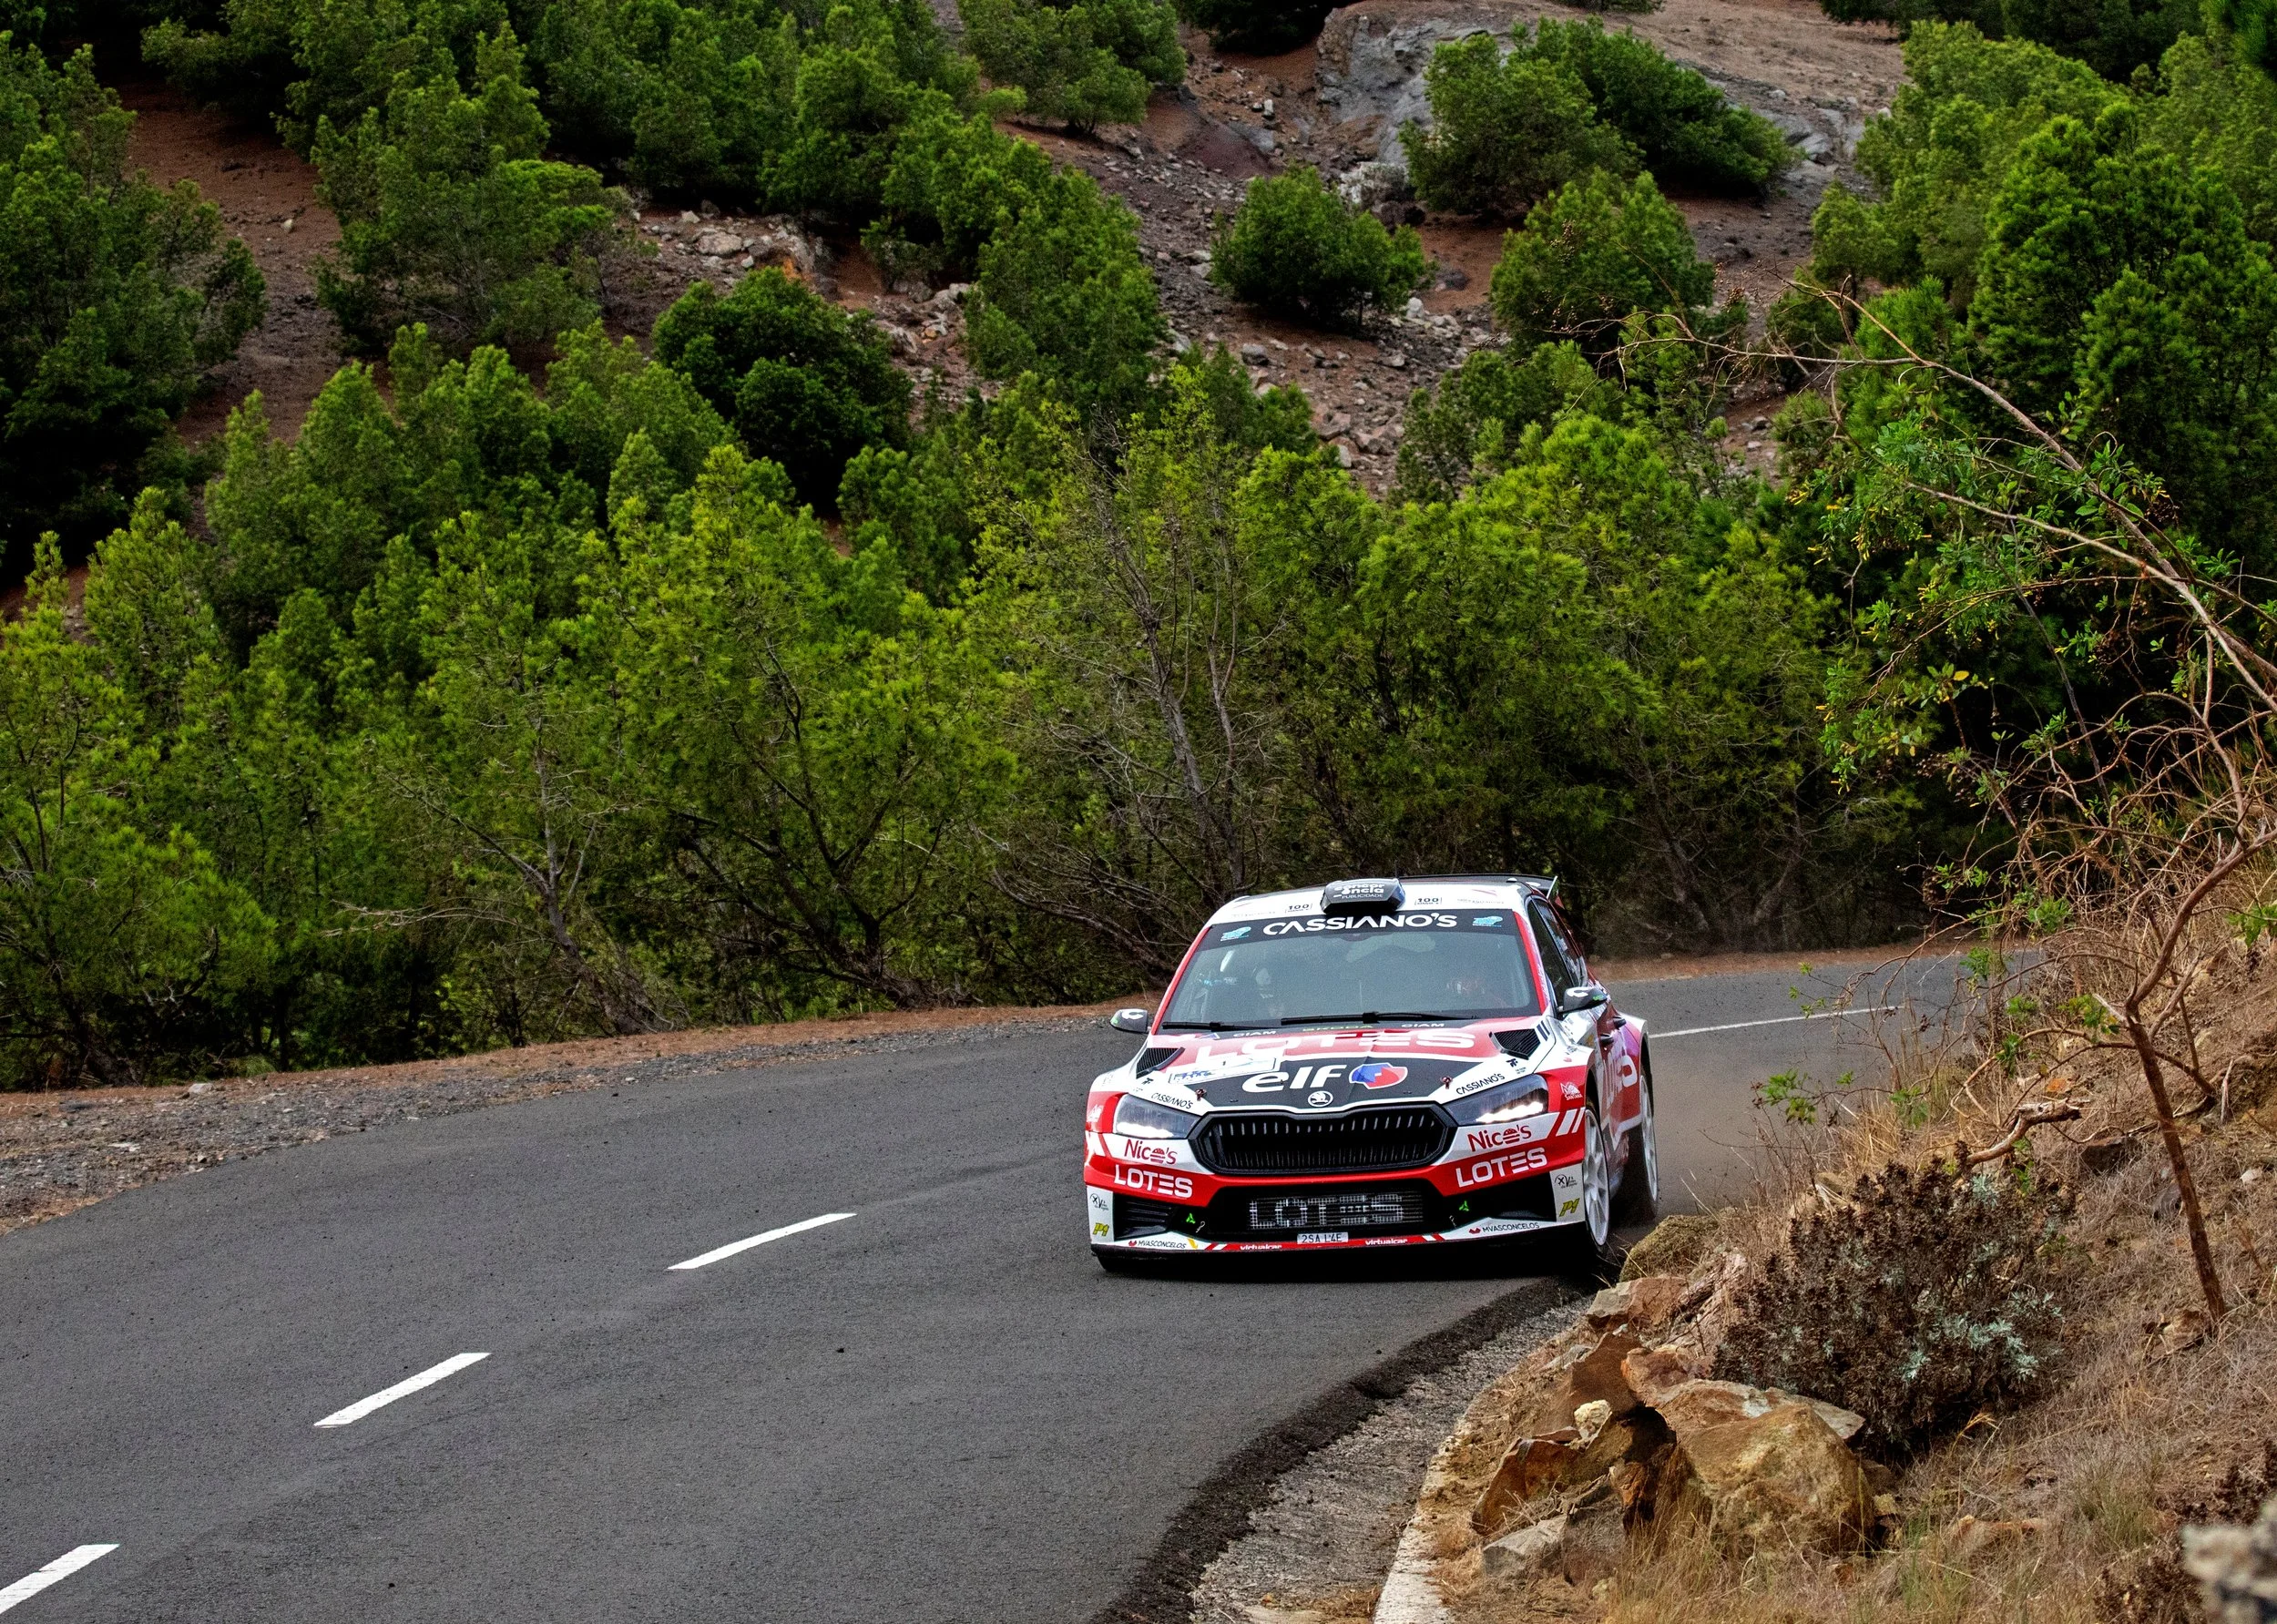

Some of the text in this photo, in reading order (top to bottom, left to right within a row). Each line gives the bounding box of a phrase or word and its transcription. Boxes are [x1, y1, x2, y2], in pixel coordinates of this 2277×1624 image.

[1262, 913, 1457, 935] CASSIANO'S
[1195, 1030, 1475, 1066] LOTES
[1241, 1064, 1347, 1092] elf
[1455, 1073, 1506, 1095] CASSIANO'S
[1150, 1092, 1194, 1109] CASSIANO'S
[1455, 1147, 1547, 1188] LOTES
[1113, 1164, 1193, 1199] LOTES
[1249, 1194, 1404, 1229] LOTES
[1482, 1222, 1540, 1233] MVASCONCELOS
[1138, 1240, 1187, 1249] MVASCONCELOS
[1365, 1237, 1408, 1245] virtualcar
